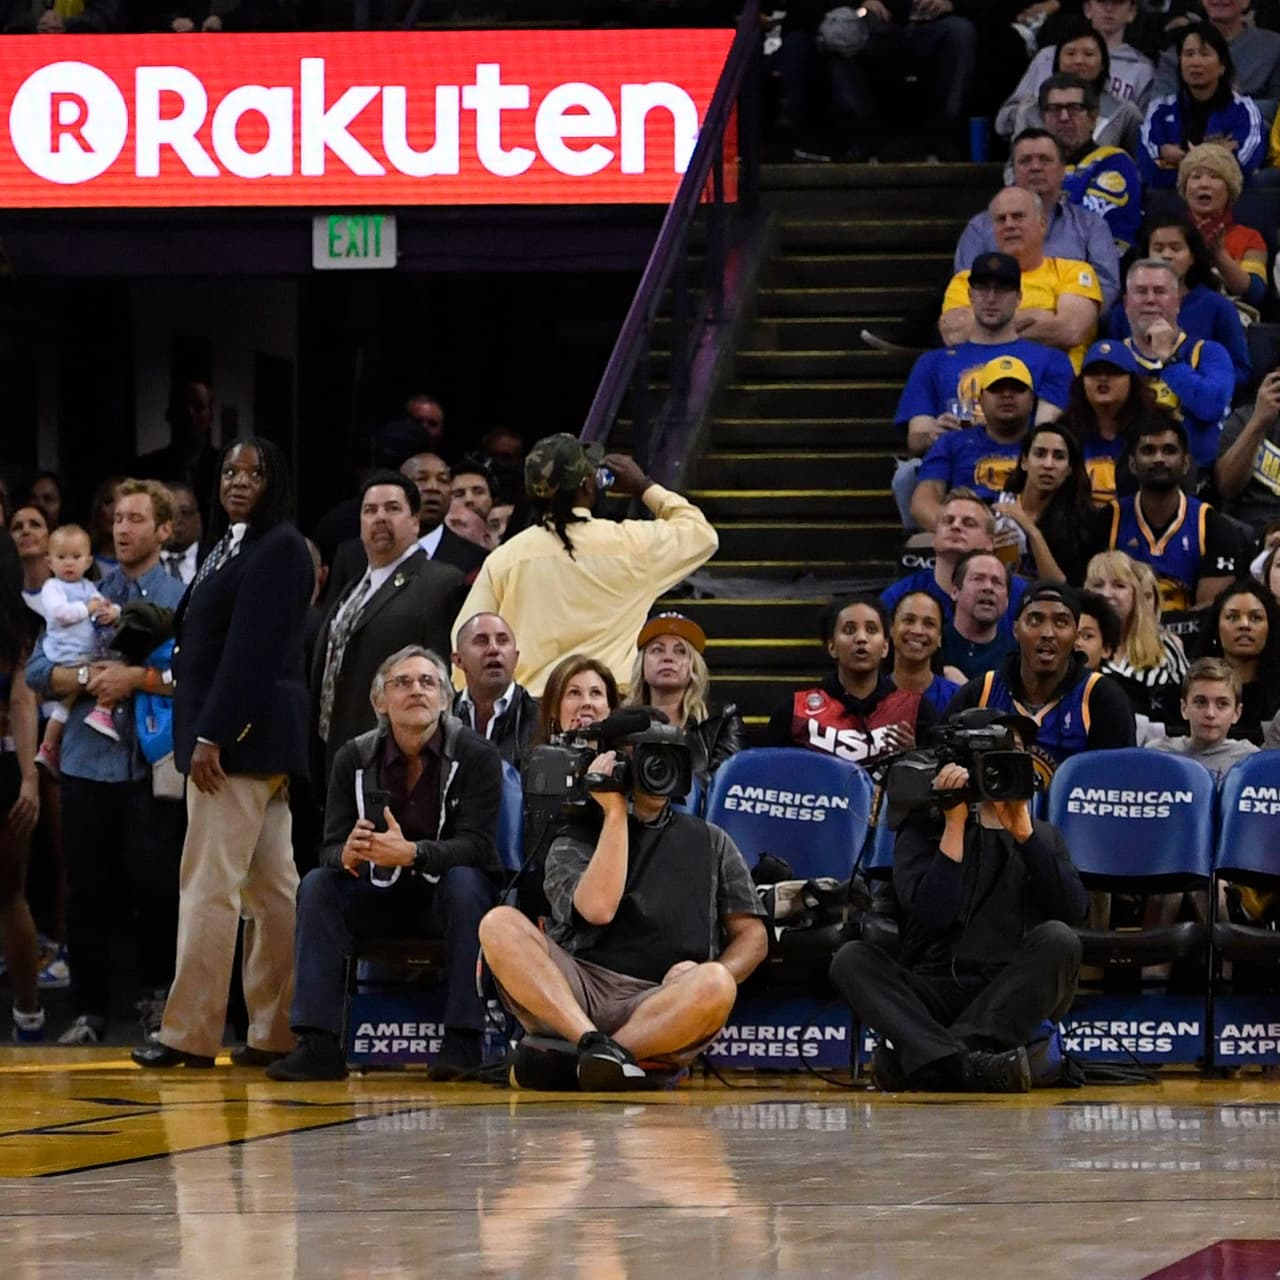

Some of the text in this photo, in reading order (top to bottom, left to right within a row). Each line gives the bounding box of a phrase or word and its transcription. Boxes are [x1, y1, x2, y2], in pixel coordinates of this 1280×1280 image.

[134, 57, 700, 179] Rakuten
[327, 215, 384, 259] EXIT
[726, 783, 850, 810] AMERICAN
[1069, 786, 1193, 805] AMERICAN
[723, 796, 827, 823] EXPRESS
[1066, 801, 1171, 819] EXPRESS
[355, 1022, 445, 1038] AMERI
[720, 1025, 847, 1042] MERICAN
[353, 1039, 443, 1055] EXPRE
[708, 1041, 820, 1058] XPRESS
[1063, 1037, 1173, 1053] XPRESS
